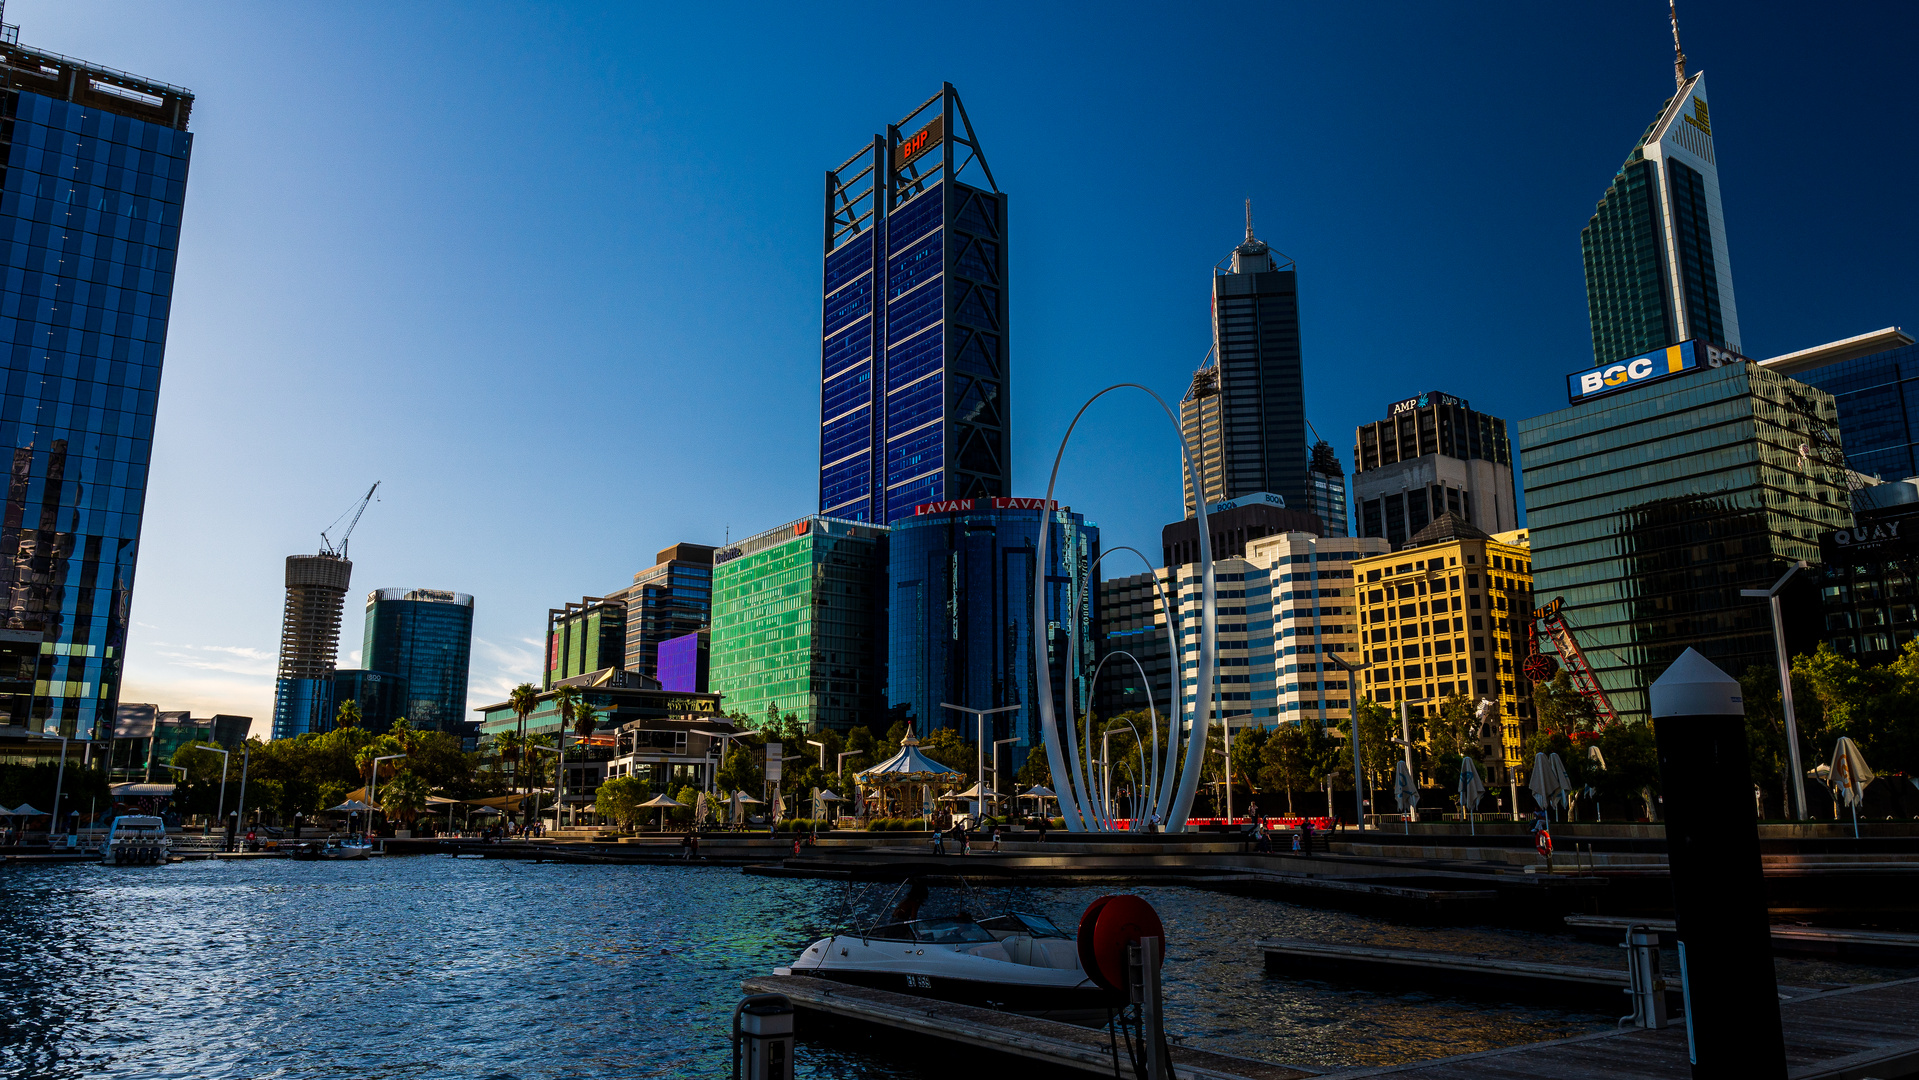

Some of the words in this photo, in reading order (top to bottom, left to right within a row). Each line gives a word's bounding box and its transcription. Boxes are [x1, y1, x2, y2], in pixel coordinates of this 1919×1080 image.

[904, 130, 928, 158] BHP
[1580, 358, 1653, 394] BGC
[1393, 399, 1416, 414] AMP
[1265, 494, 1279, 503] BOQ
[917, 500, 971, 515] LAVAN
[1217, 501, 1232, 512] BOQ
[1834, 520, 1900, 544] QUAY
